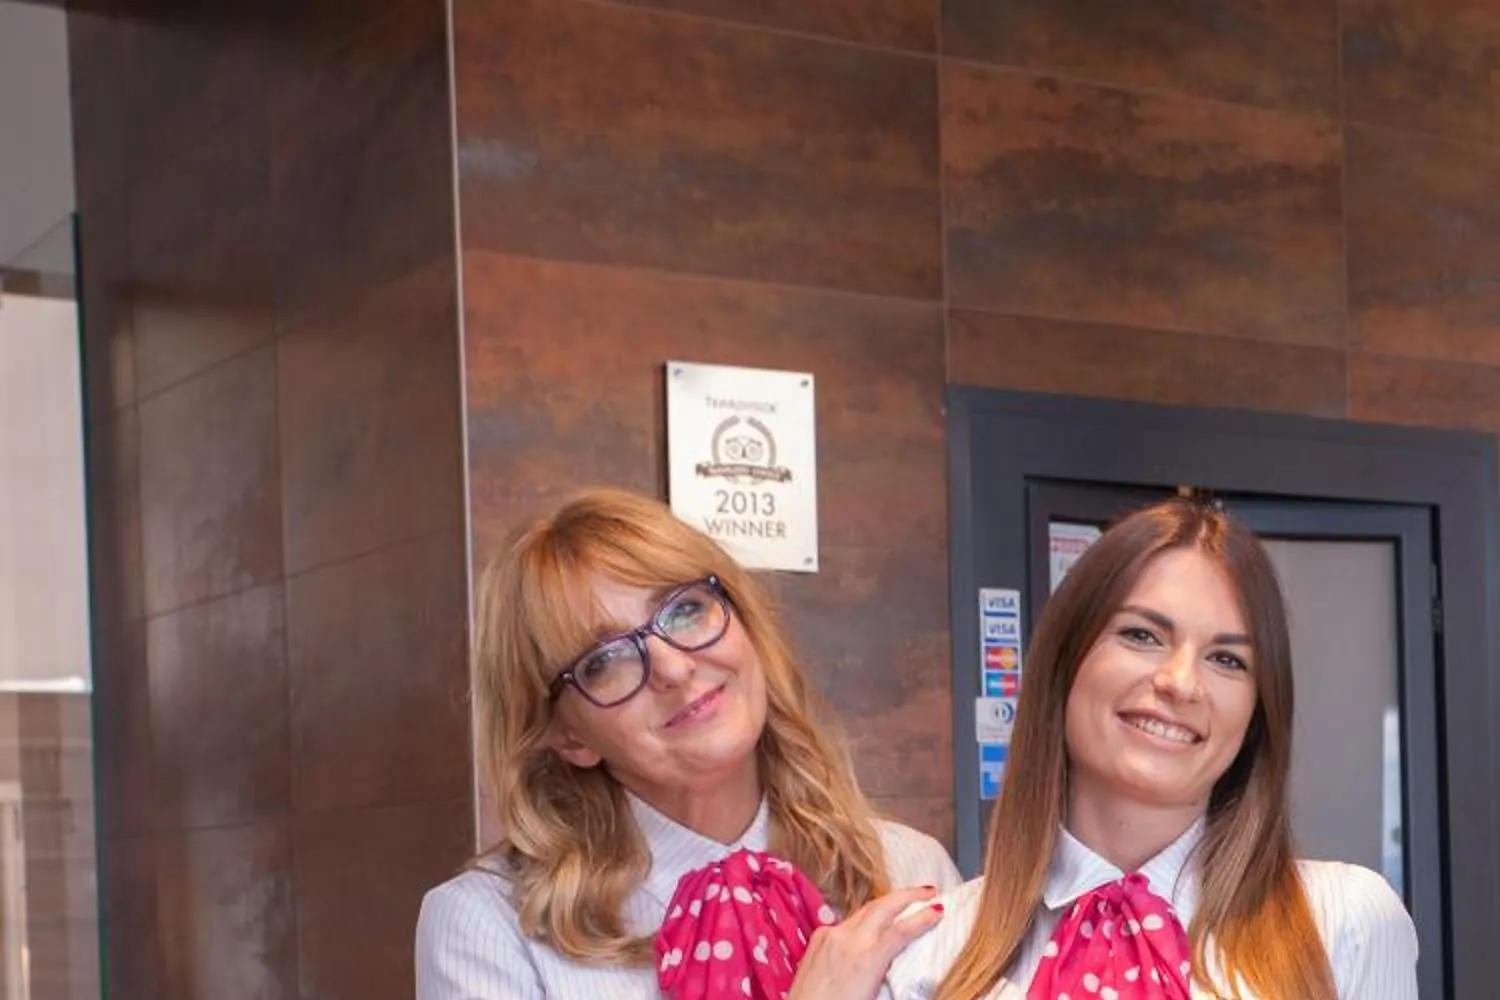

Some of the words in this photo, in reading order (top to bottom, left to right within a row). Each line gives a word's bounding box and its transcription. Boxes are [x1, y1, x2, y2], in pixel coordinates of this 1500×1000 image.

[714, 489, 776, 517] 2013
[703, 517, 787, 540] WINNER
[987, 596, 1016, 608] VISA
[988, 623, 1017, 635] VISA
